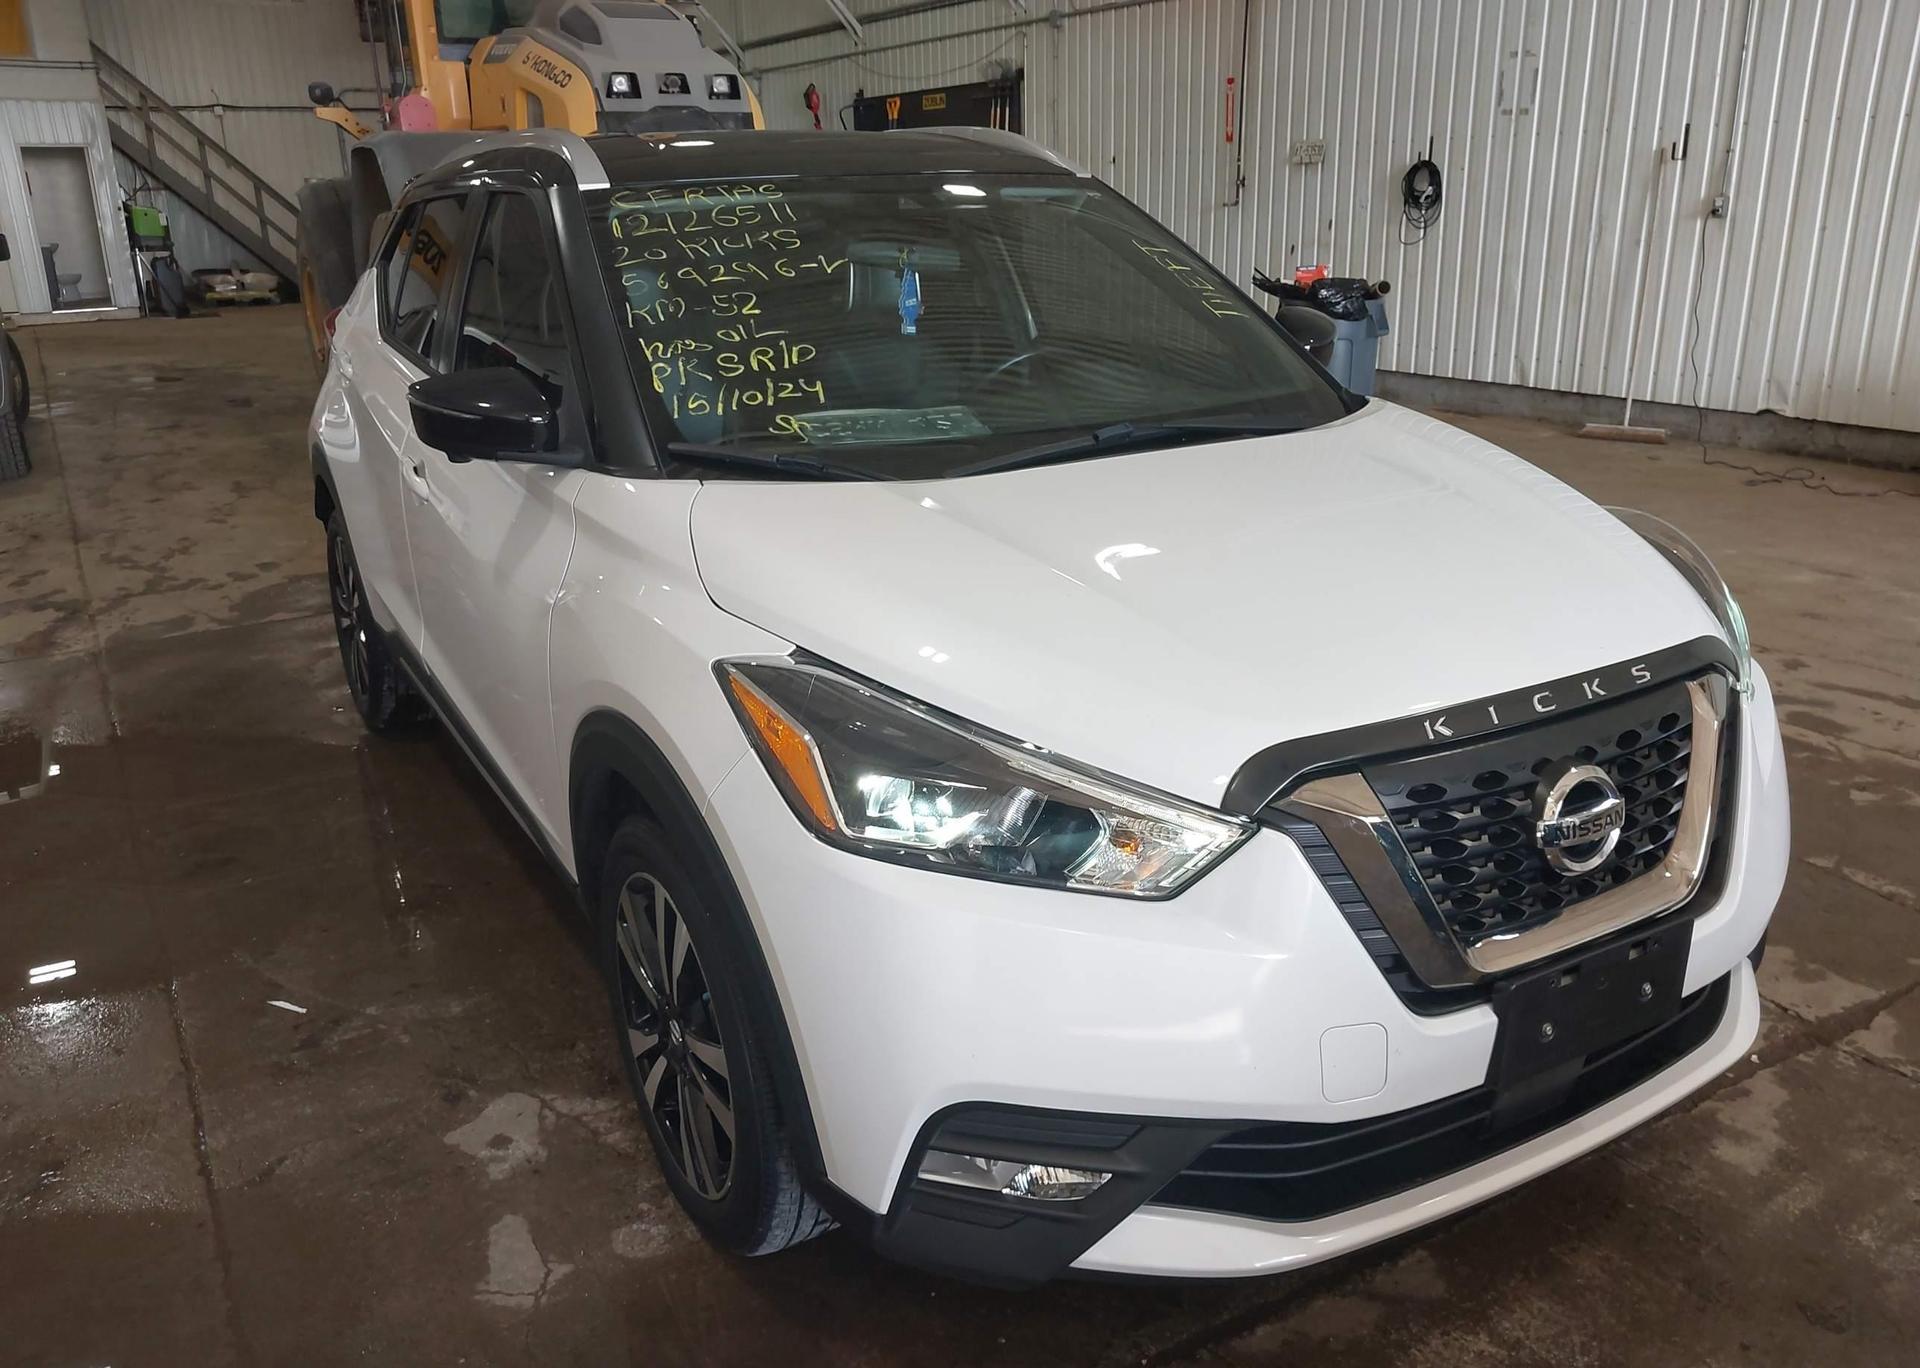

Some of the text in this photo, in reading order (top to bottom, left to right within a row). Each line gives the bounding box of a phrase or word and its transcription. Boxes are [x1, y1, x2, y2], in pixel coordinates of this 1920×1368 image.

[612, 229, 800, 267] 20 KICKS
[1423, 664, 1652, 740] KICKS
[1556, 806, 1625, 841] NISSAN
